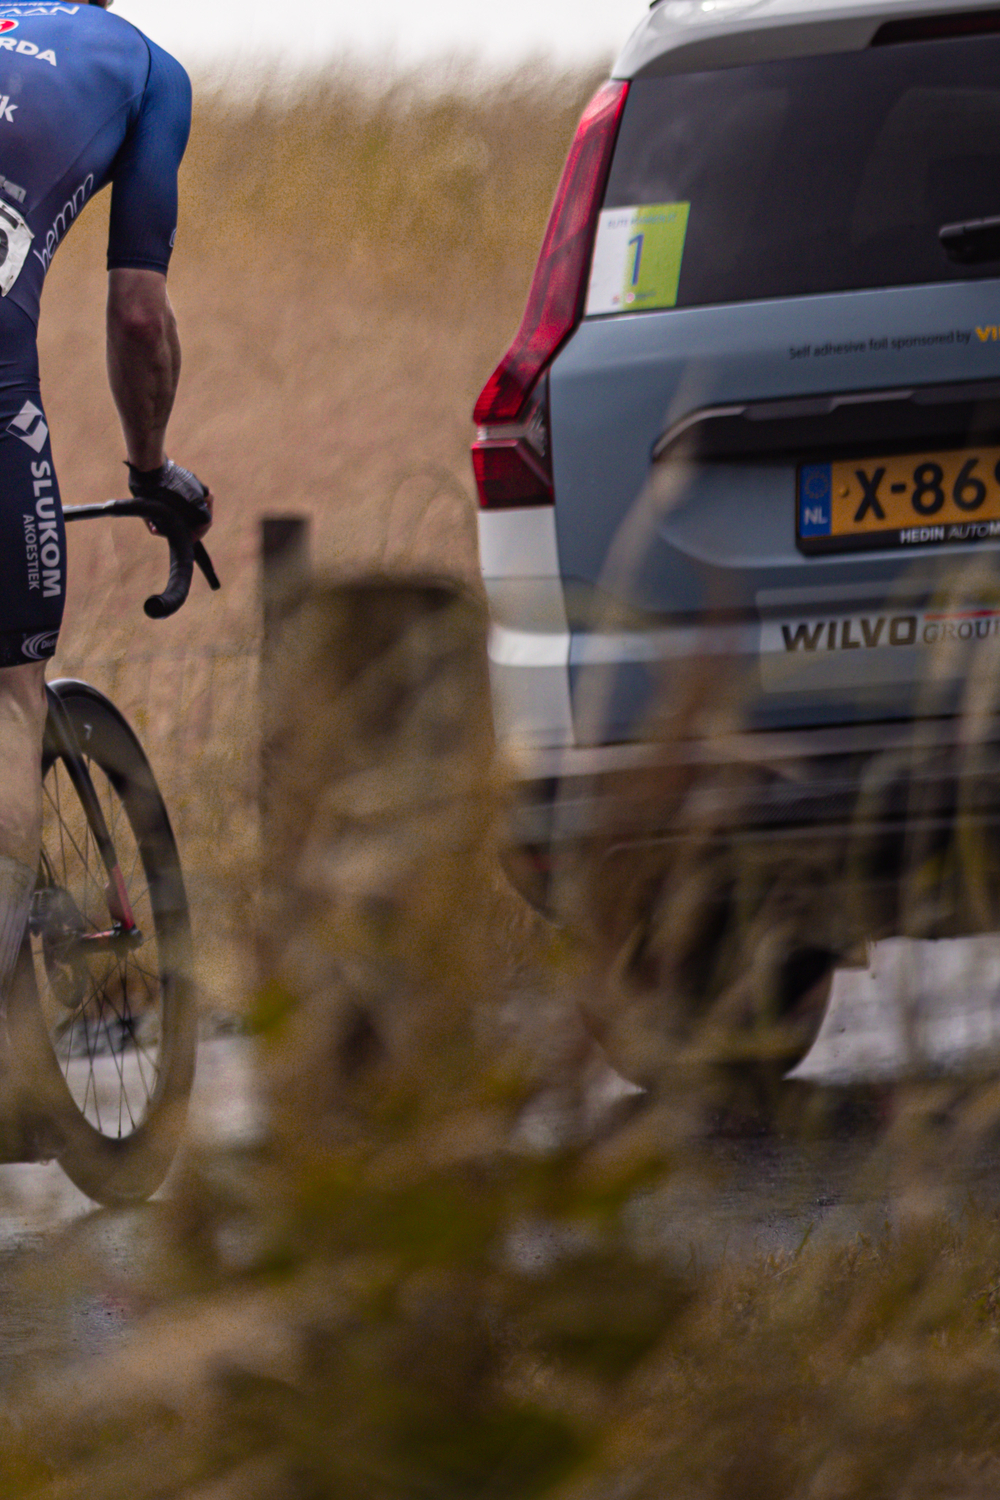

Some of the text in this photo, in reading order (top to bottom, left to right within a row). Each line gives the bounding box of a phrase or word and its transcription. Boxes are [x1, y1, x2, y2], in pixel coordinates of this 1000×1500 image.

[628, 233, 645, 286] 1
[813, 340, 867, 358] adhesive
[869, 337, 889, 350] foil
[890, 330, 954, 350] sponsored
[956, 329, 972, 346] by
[853, 456, 1000, 522] X-86
[31, 460, 62, 599] SLUKOM
[804, 506, 829, 526] NL
[900, 527, 945, 544] HEDIN
[22, 513, 40, 591] AKOESTIEK
[781, 616, 918, 652] WILVO
